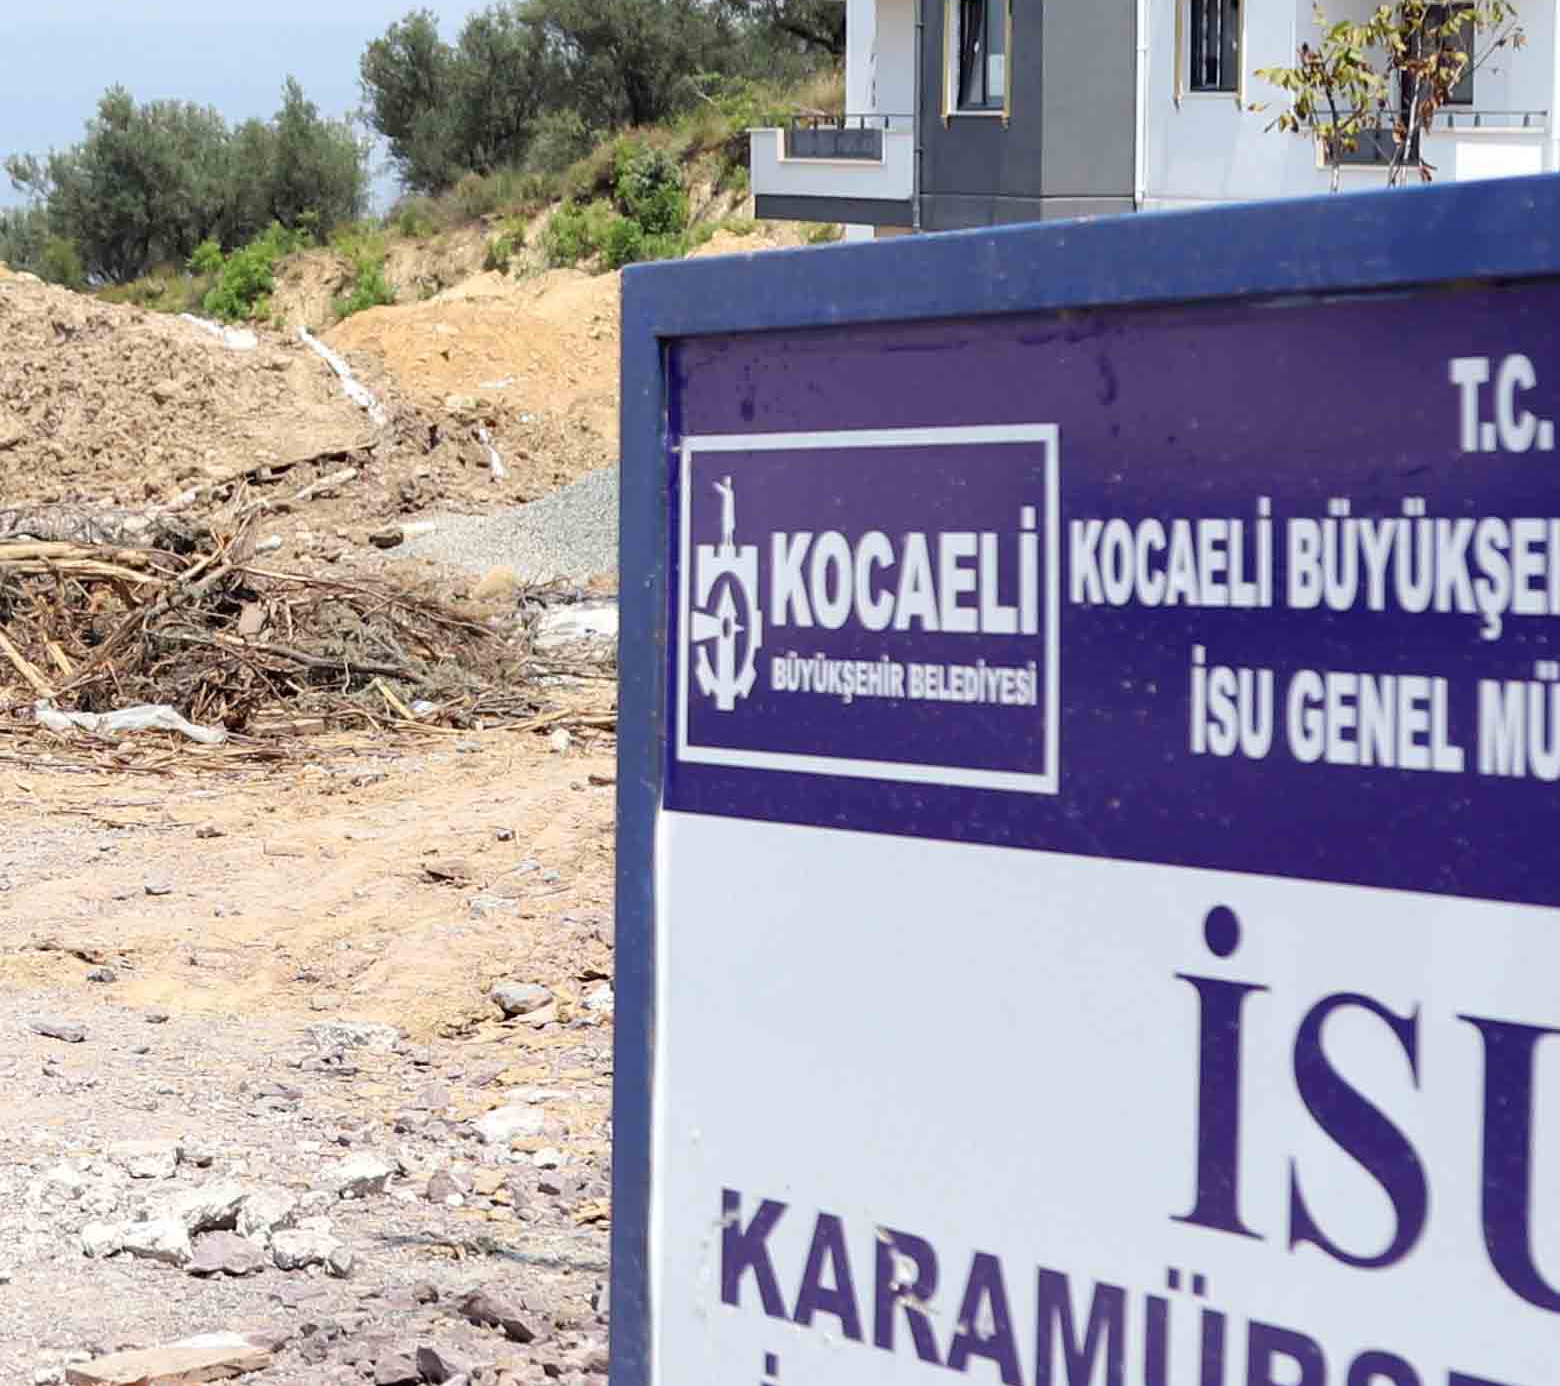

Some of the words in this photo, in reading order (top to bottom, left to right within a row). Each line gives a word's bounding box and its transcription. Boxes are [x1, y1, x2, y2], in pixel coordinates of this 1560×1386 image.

[1448, 353, 1555, 454] T.C.
[770, 505, 1039, 636] KOCAELİ
[1068, 496, 1274, 609] KOCAELİ
[770, 649, 906, 705] BÜYÜKŞEHİR
[906, 657, 1038, 707] BELEDİYESİ
[1189, 643, 1275, 760] İSU
[1285, 668, 1466, 774] GENEL
